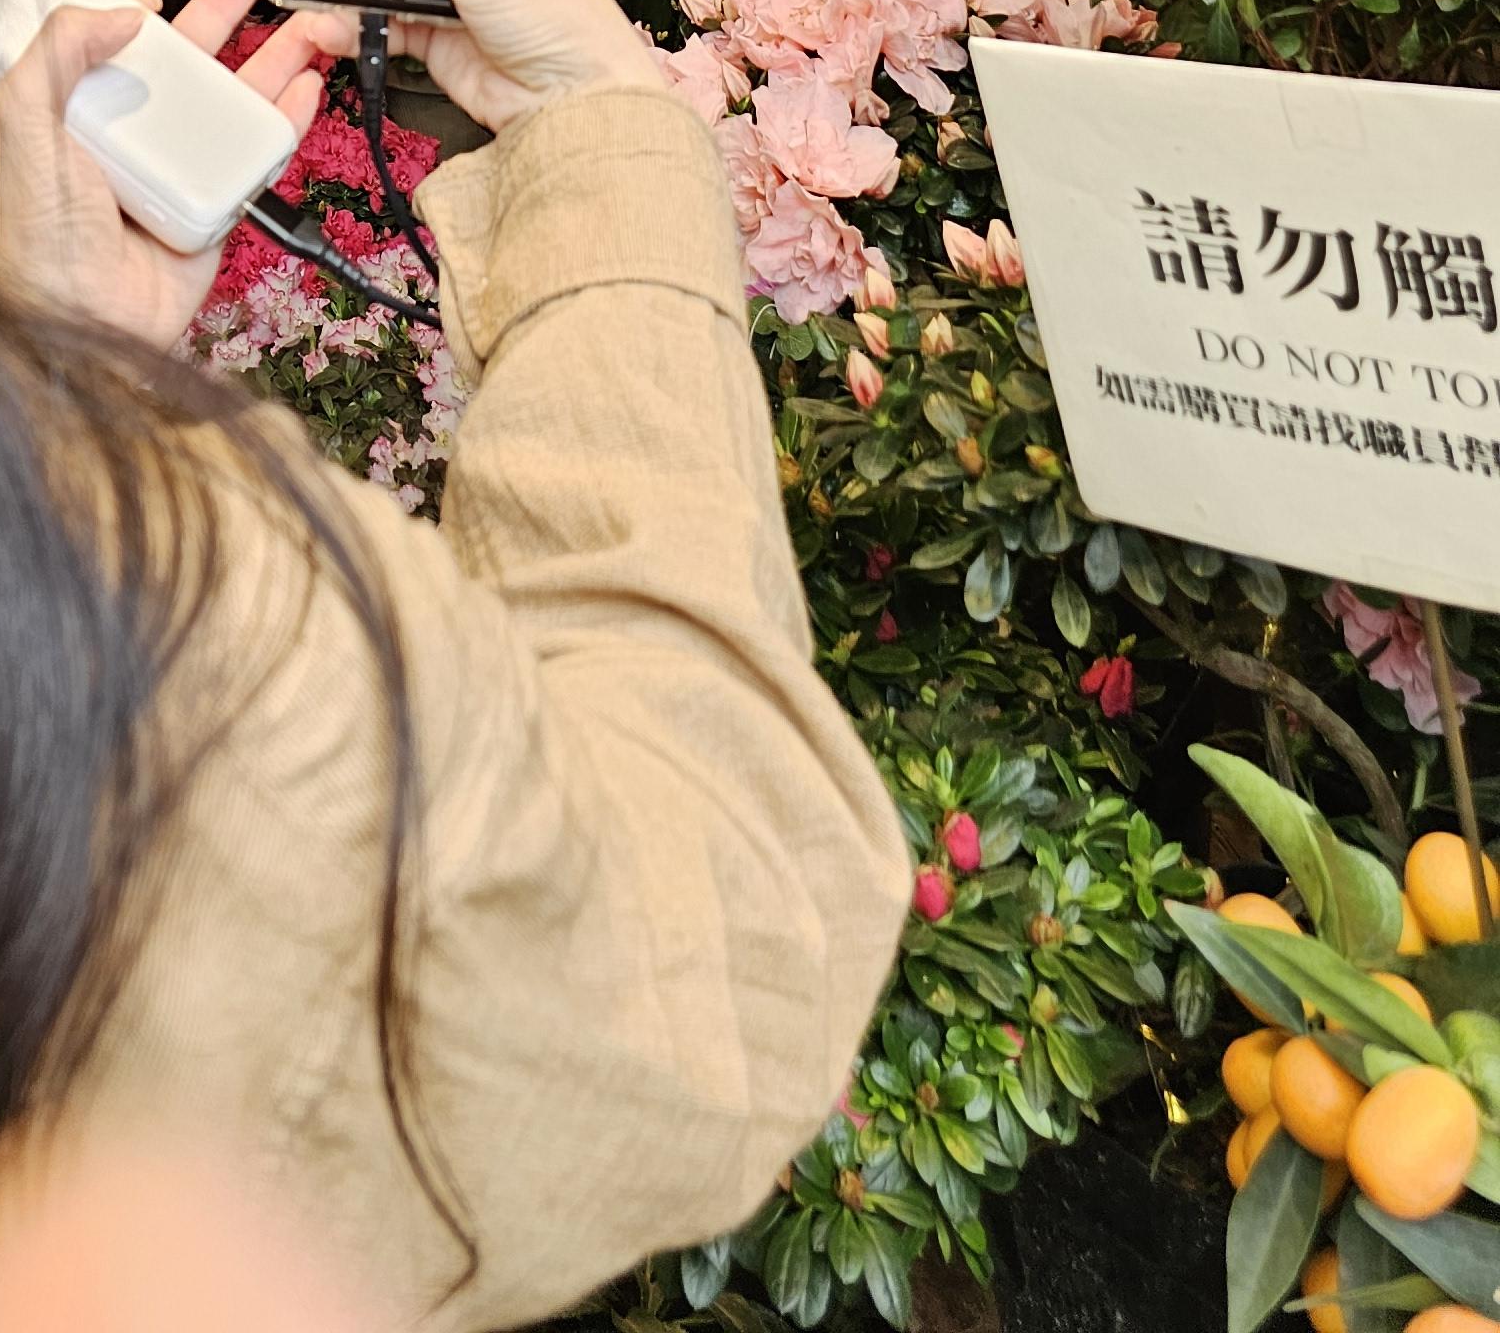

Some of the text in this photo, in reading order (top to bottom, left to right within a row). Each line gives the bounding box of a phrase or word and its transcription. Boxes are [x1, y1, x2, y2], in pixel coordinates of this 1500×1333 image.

[1132, 187, 1498, 333] 請勿觸
[1190, 327, 1265, 369] DO
[1282, 342, 1394, 394] NOT
